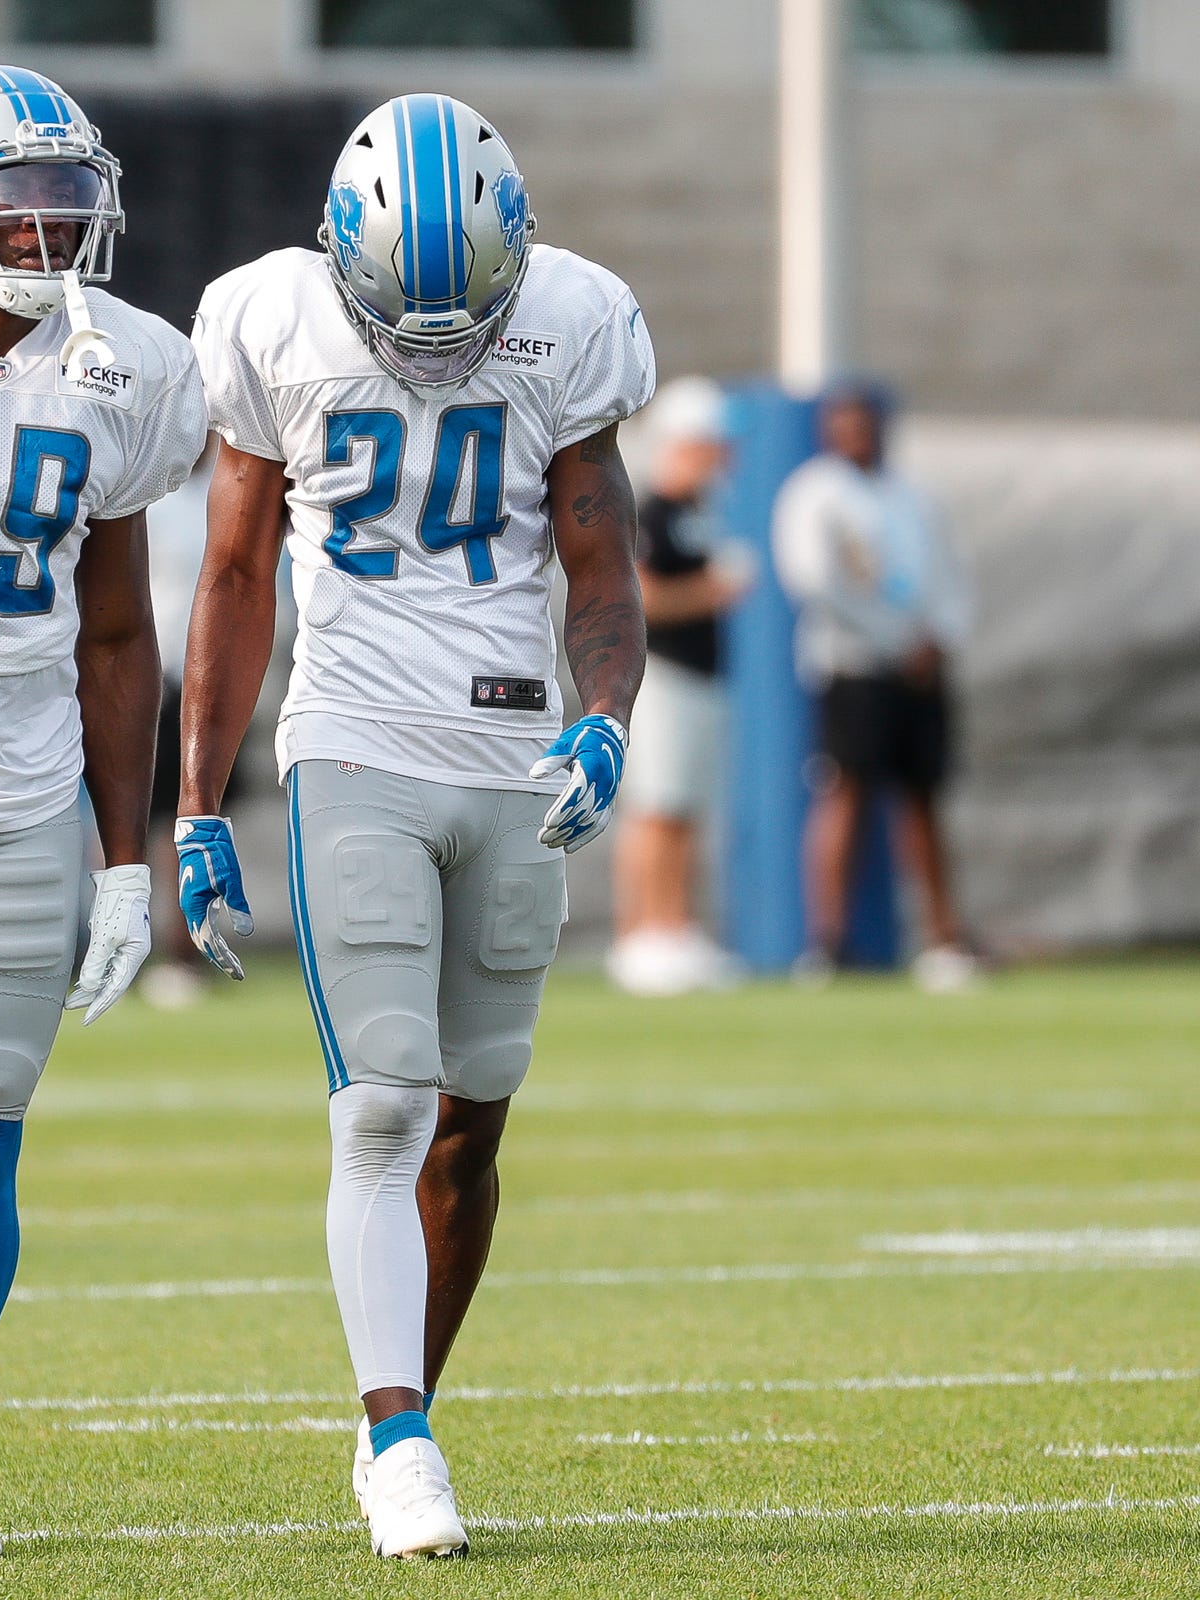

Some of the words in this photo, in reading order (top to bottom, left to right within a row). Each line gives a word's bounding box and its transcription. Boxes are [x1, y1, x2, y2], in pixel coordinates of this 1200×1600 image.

[491, 352, 539, 367] Mortgage
[77, 381, 117, 397] Mortgage
[321, 401, 511, 586] 24
